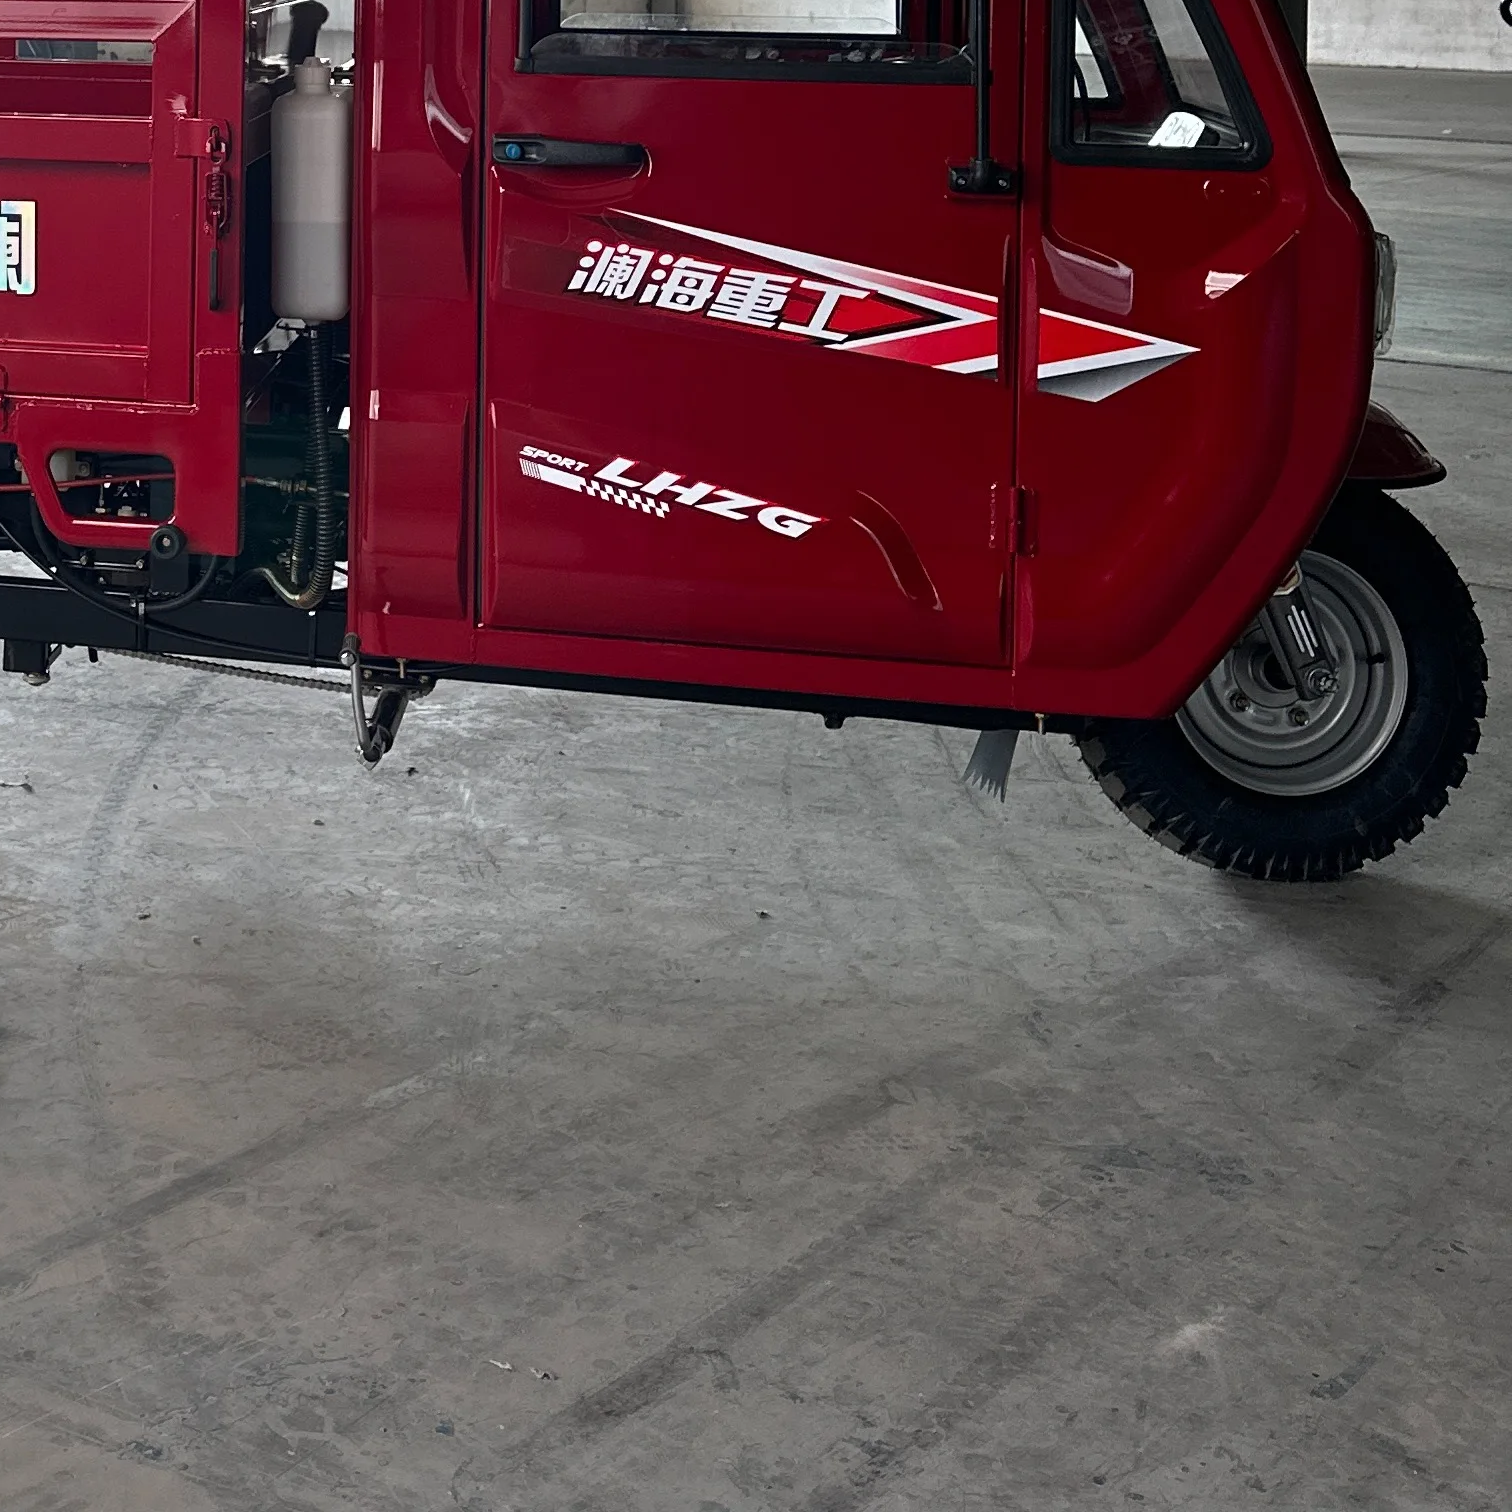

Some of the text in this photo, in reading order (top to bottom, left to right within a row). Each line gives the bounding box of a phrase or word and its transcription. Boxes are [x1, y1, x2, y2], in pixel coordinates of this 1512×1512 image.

[567, 240, 871, 343] 澜海重工
[519, 445, 590, 474] SPORT
[593, 456, 823, 539] LHZG
